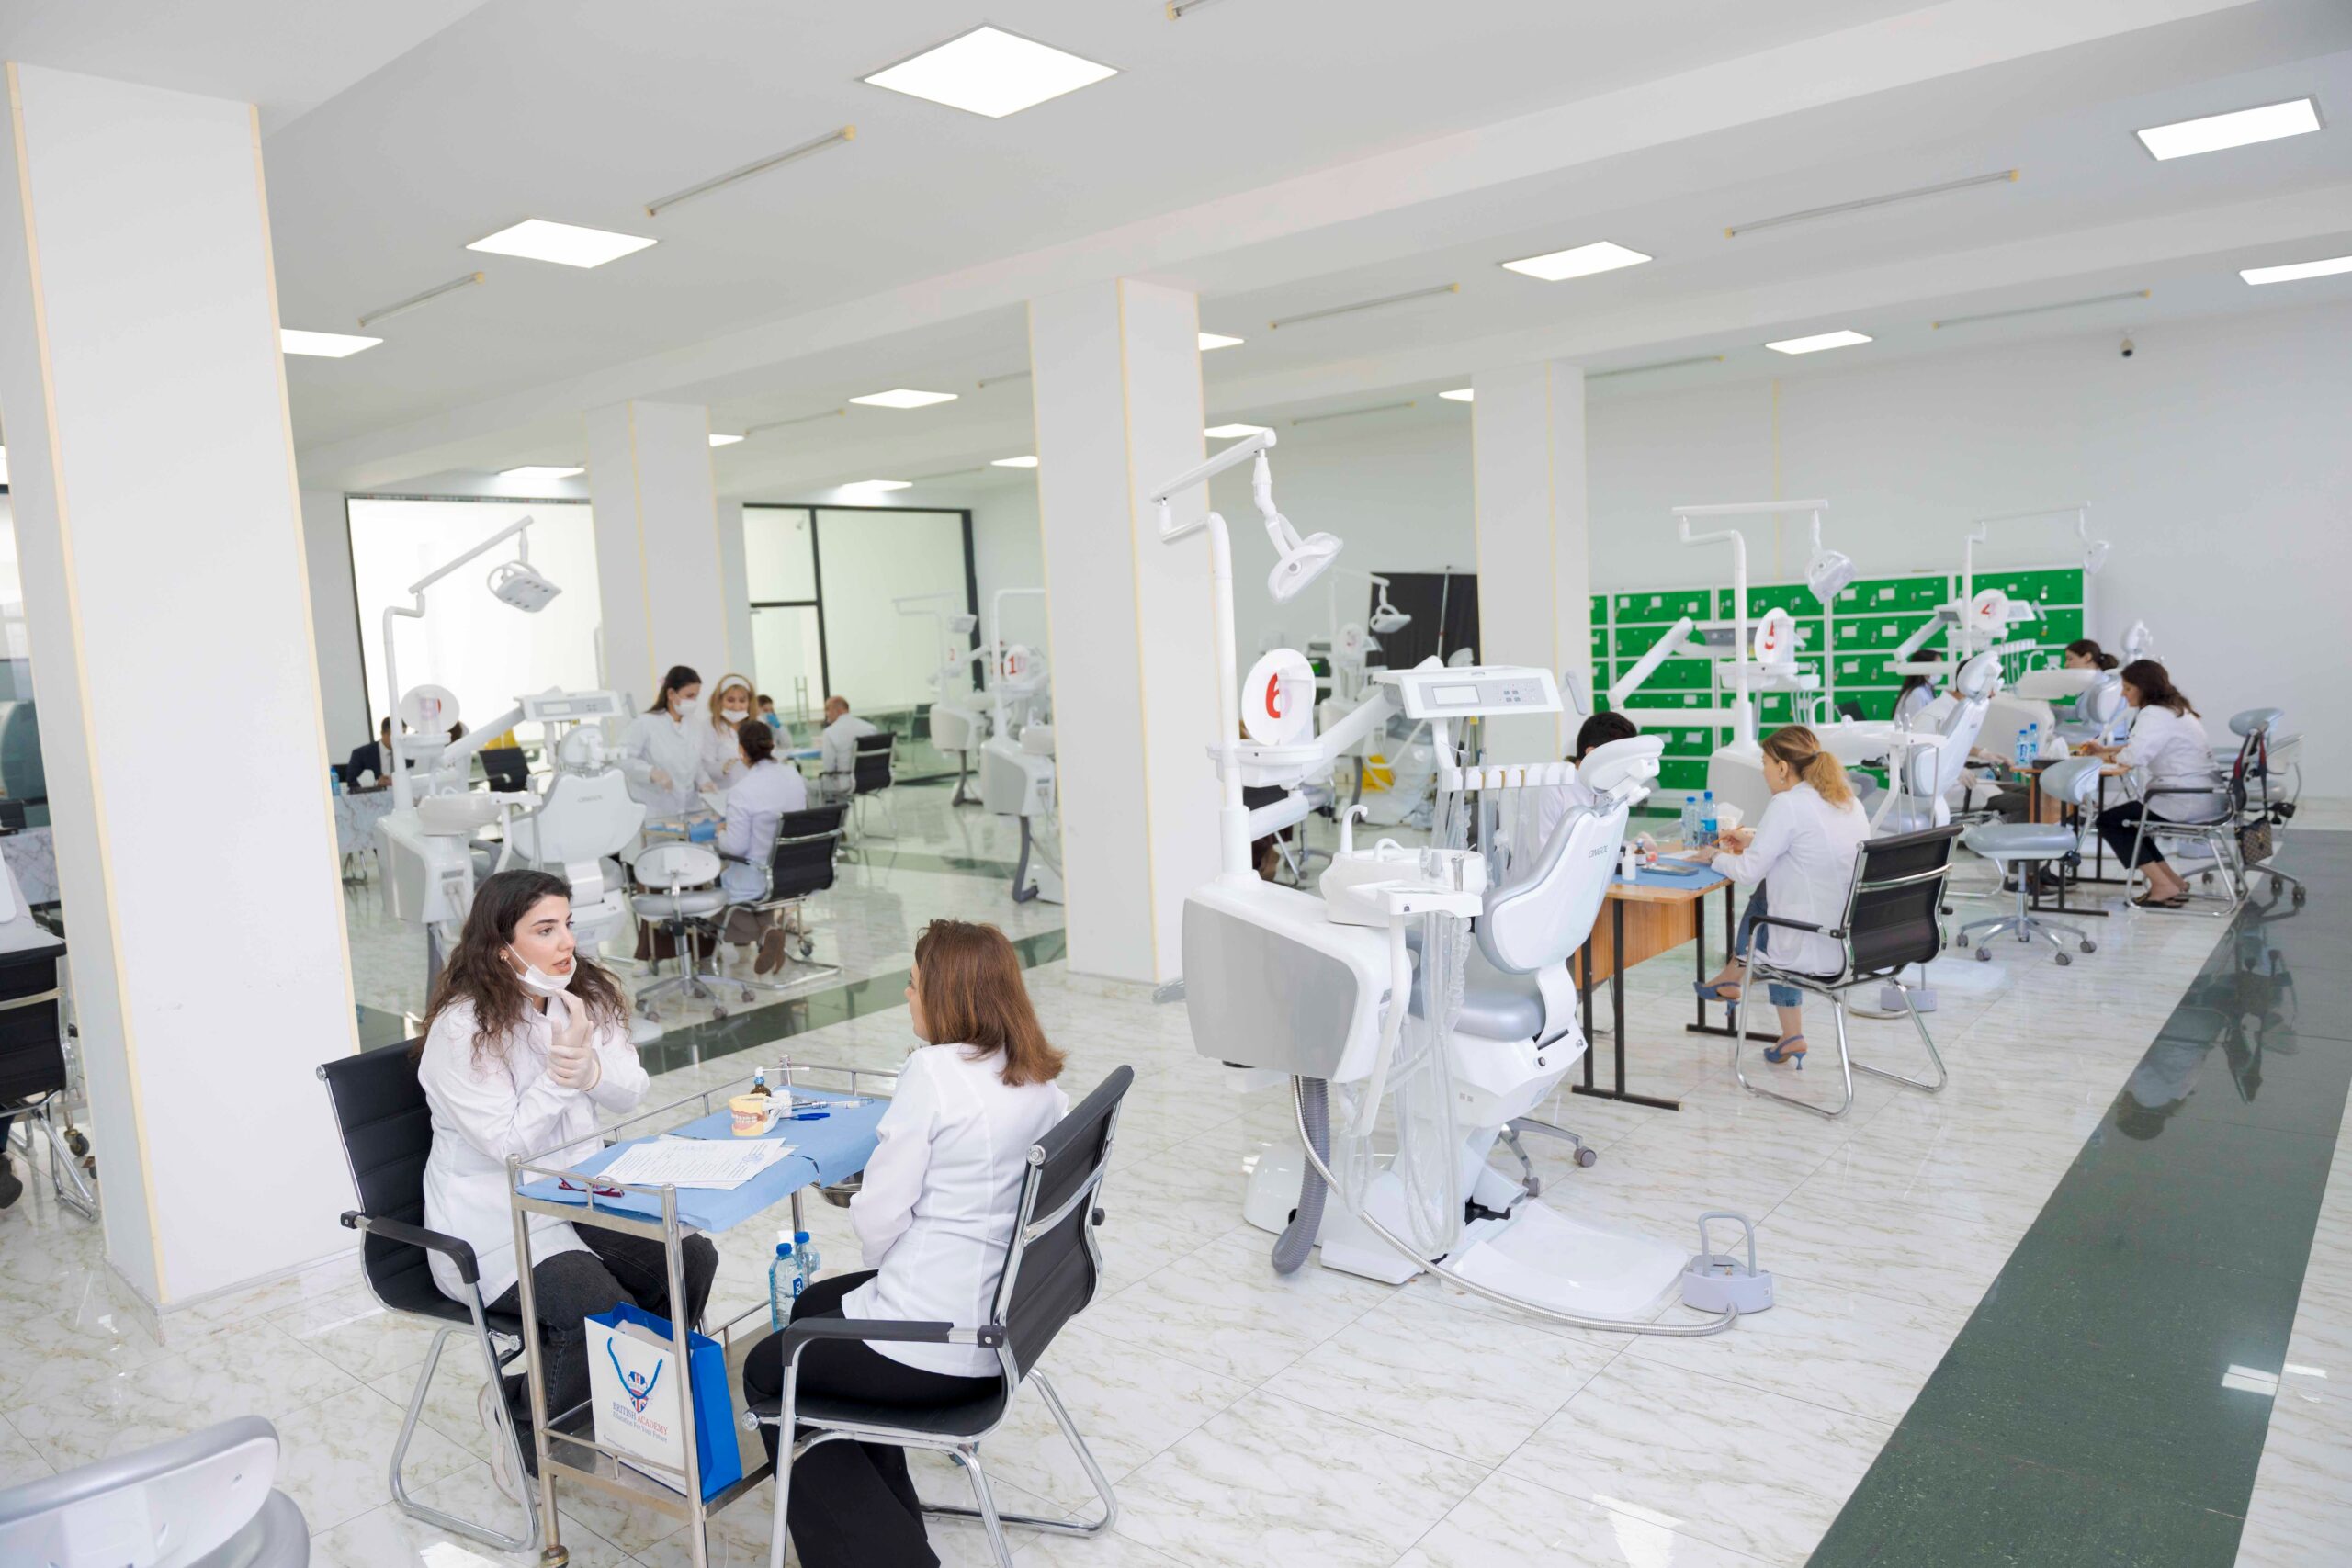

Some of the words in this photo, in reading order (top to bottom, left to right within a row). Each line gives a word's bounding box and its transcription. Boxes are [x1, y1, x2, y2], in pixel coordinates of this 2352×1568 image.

[1266, 672, 1291, 718] 6
[613, 1402, 637, 1420] BRITISH
[637, 1415, 668, 1436] ACADEMY
